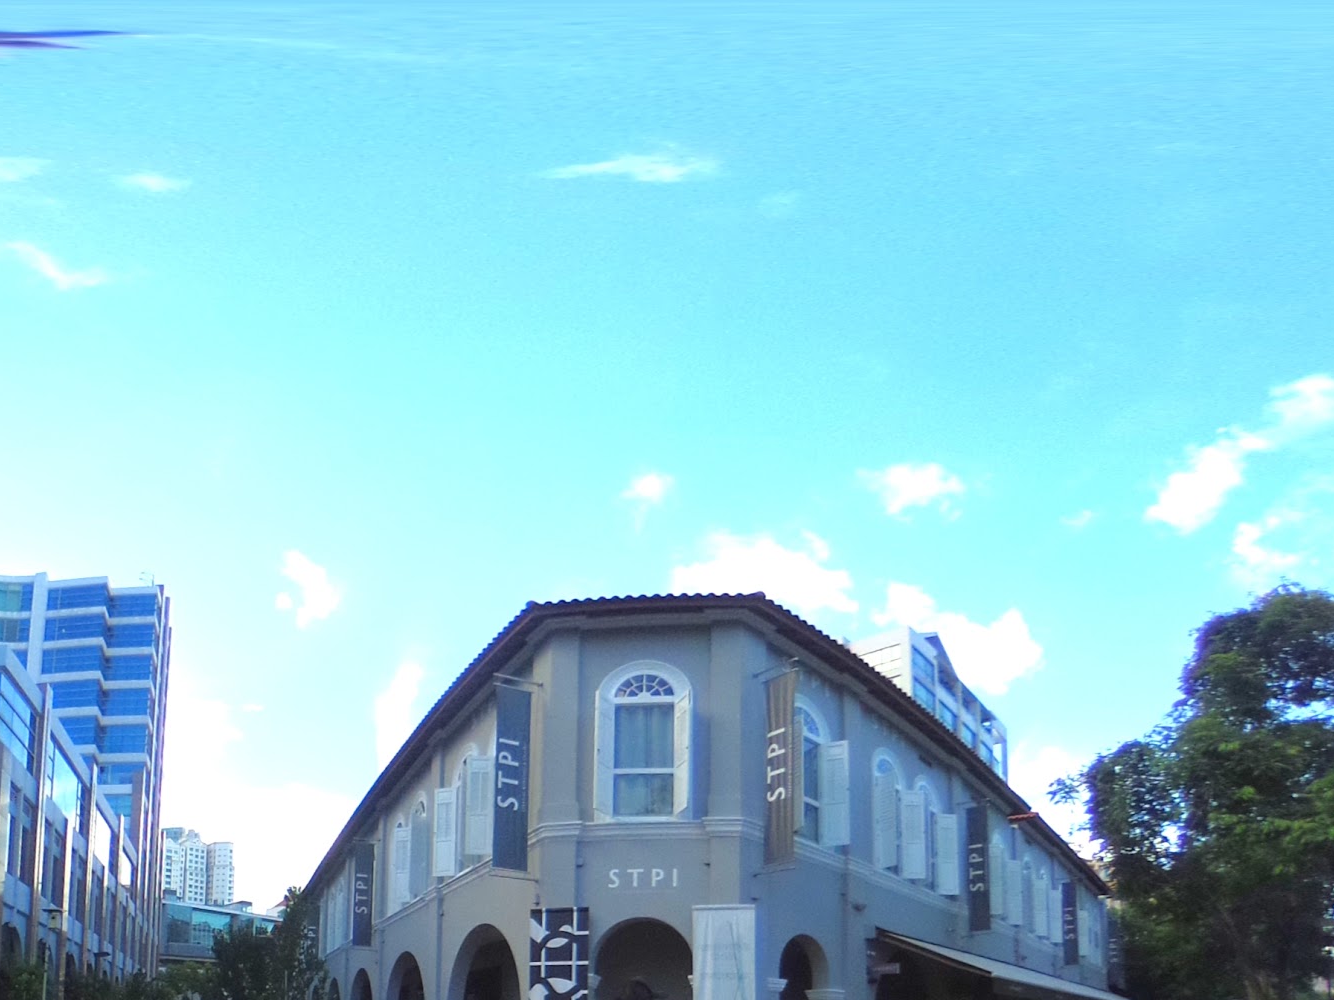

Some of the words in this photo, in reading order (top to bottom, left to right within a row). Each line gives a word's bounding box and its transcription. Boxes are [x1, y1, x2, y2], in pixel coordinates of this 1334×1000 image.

[497, 738, 520, 811] STPI
[767, 727, 785, 802] STPI
[607, 868, 678, 888] STPI
[968, 843, 984, 892] STPI
[354, 873, 369, 914] STPI
[1064, 907, 1075, 940] STPI
